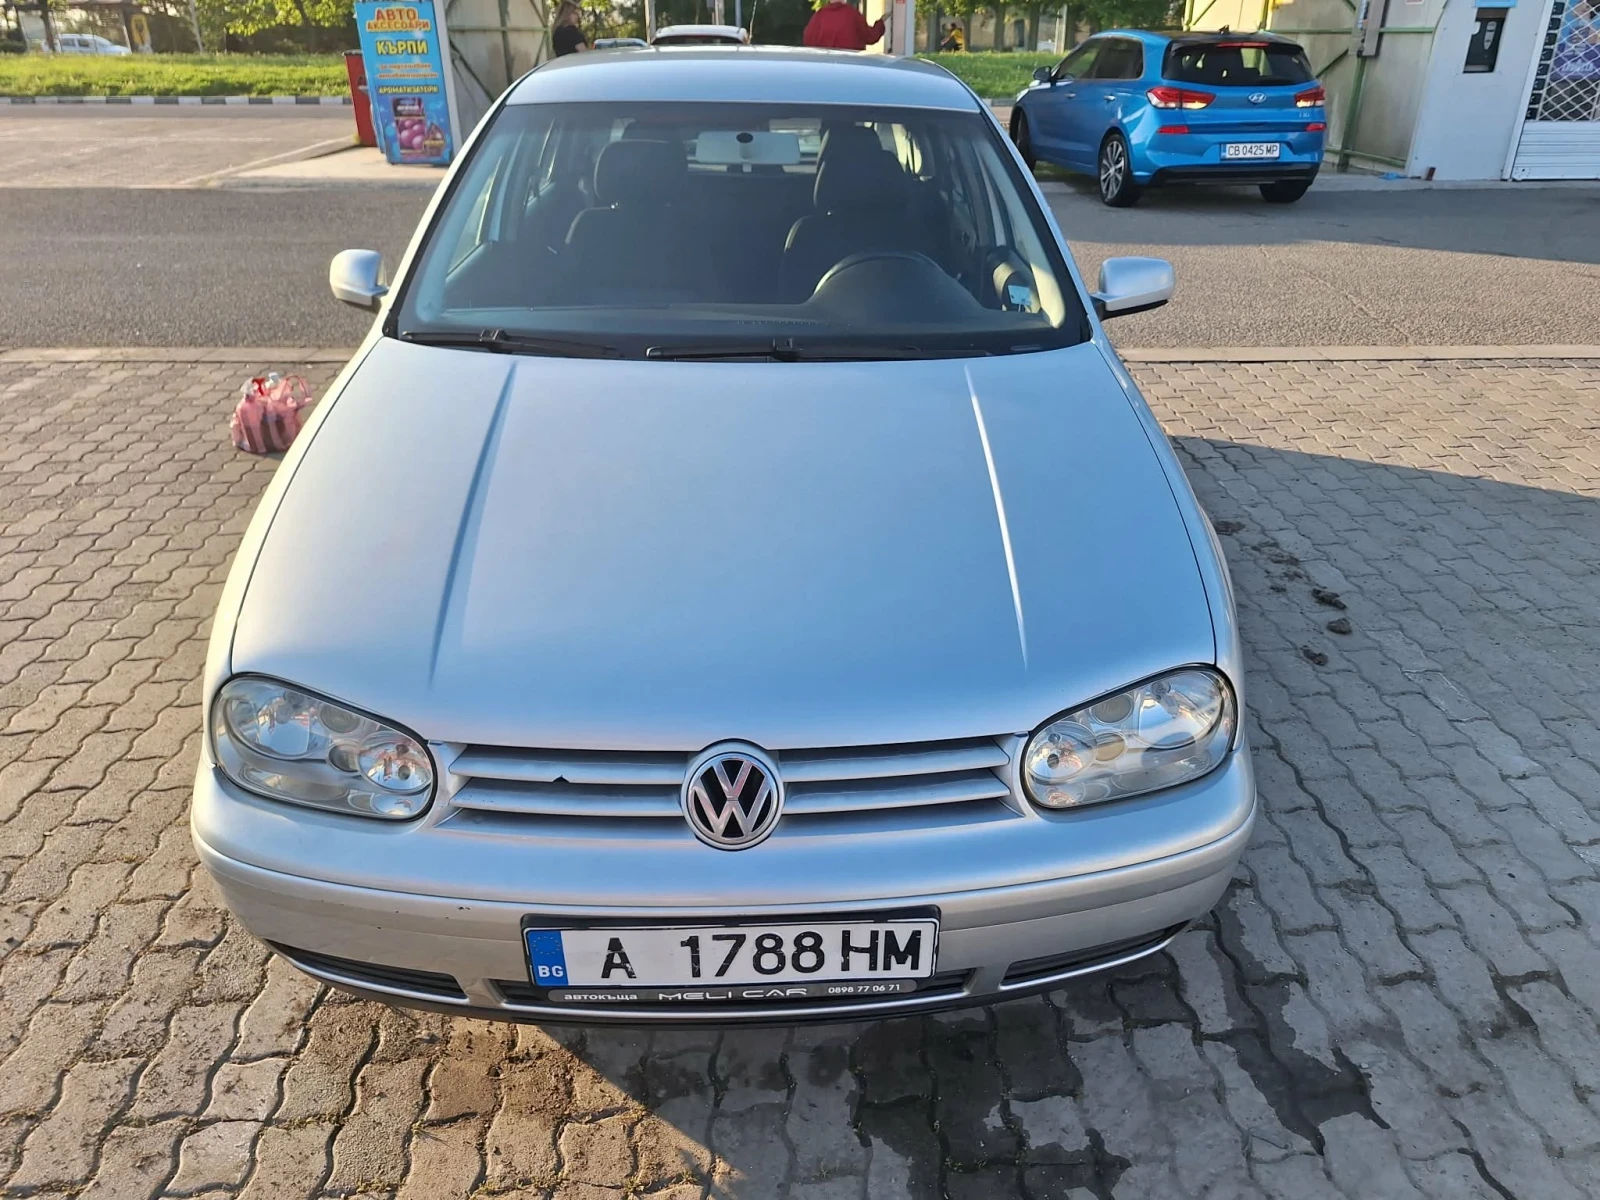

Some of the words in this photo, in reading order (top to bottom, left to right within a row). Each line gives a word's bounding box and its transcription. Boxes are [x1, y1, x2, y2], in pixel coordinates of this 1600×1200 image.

[375, 8, 418, 22] АВТО
[367, 20, 430, 31] АКСЕСОАРИ
[376, 40, 429, 55] КЪРПИ
[1227, 144, 1241, 157] CB
[1242, 143, 1265, 156] 0425
[1266, 143, 1279, 155] MP
[600, 937, 637, 979] A
[680, 930, 825, 978] 1788
[840, 929, 922, 972] HM
[538, 964, 564, 979] BG
[658, 991, 732, 1000] MELI
[742, 988, 808, 998] CAR
[828, 986, 854, 994] 0898
[857, 985, 870, 993] 77
[563, 993, 638, 1001] автокъща
